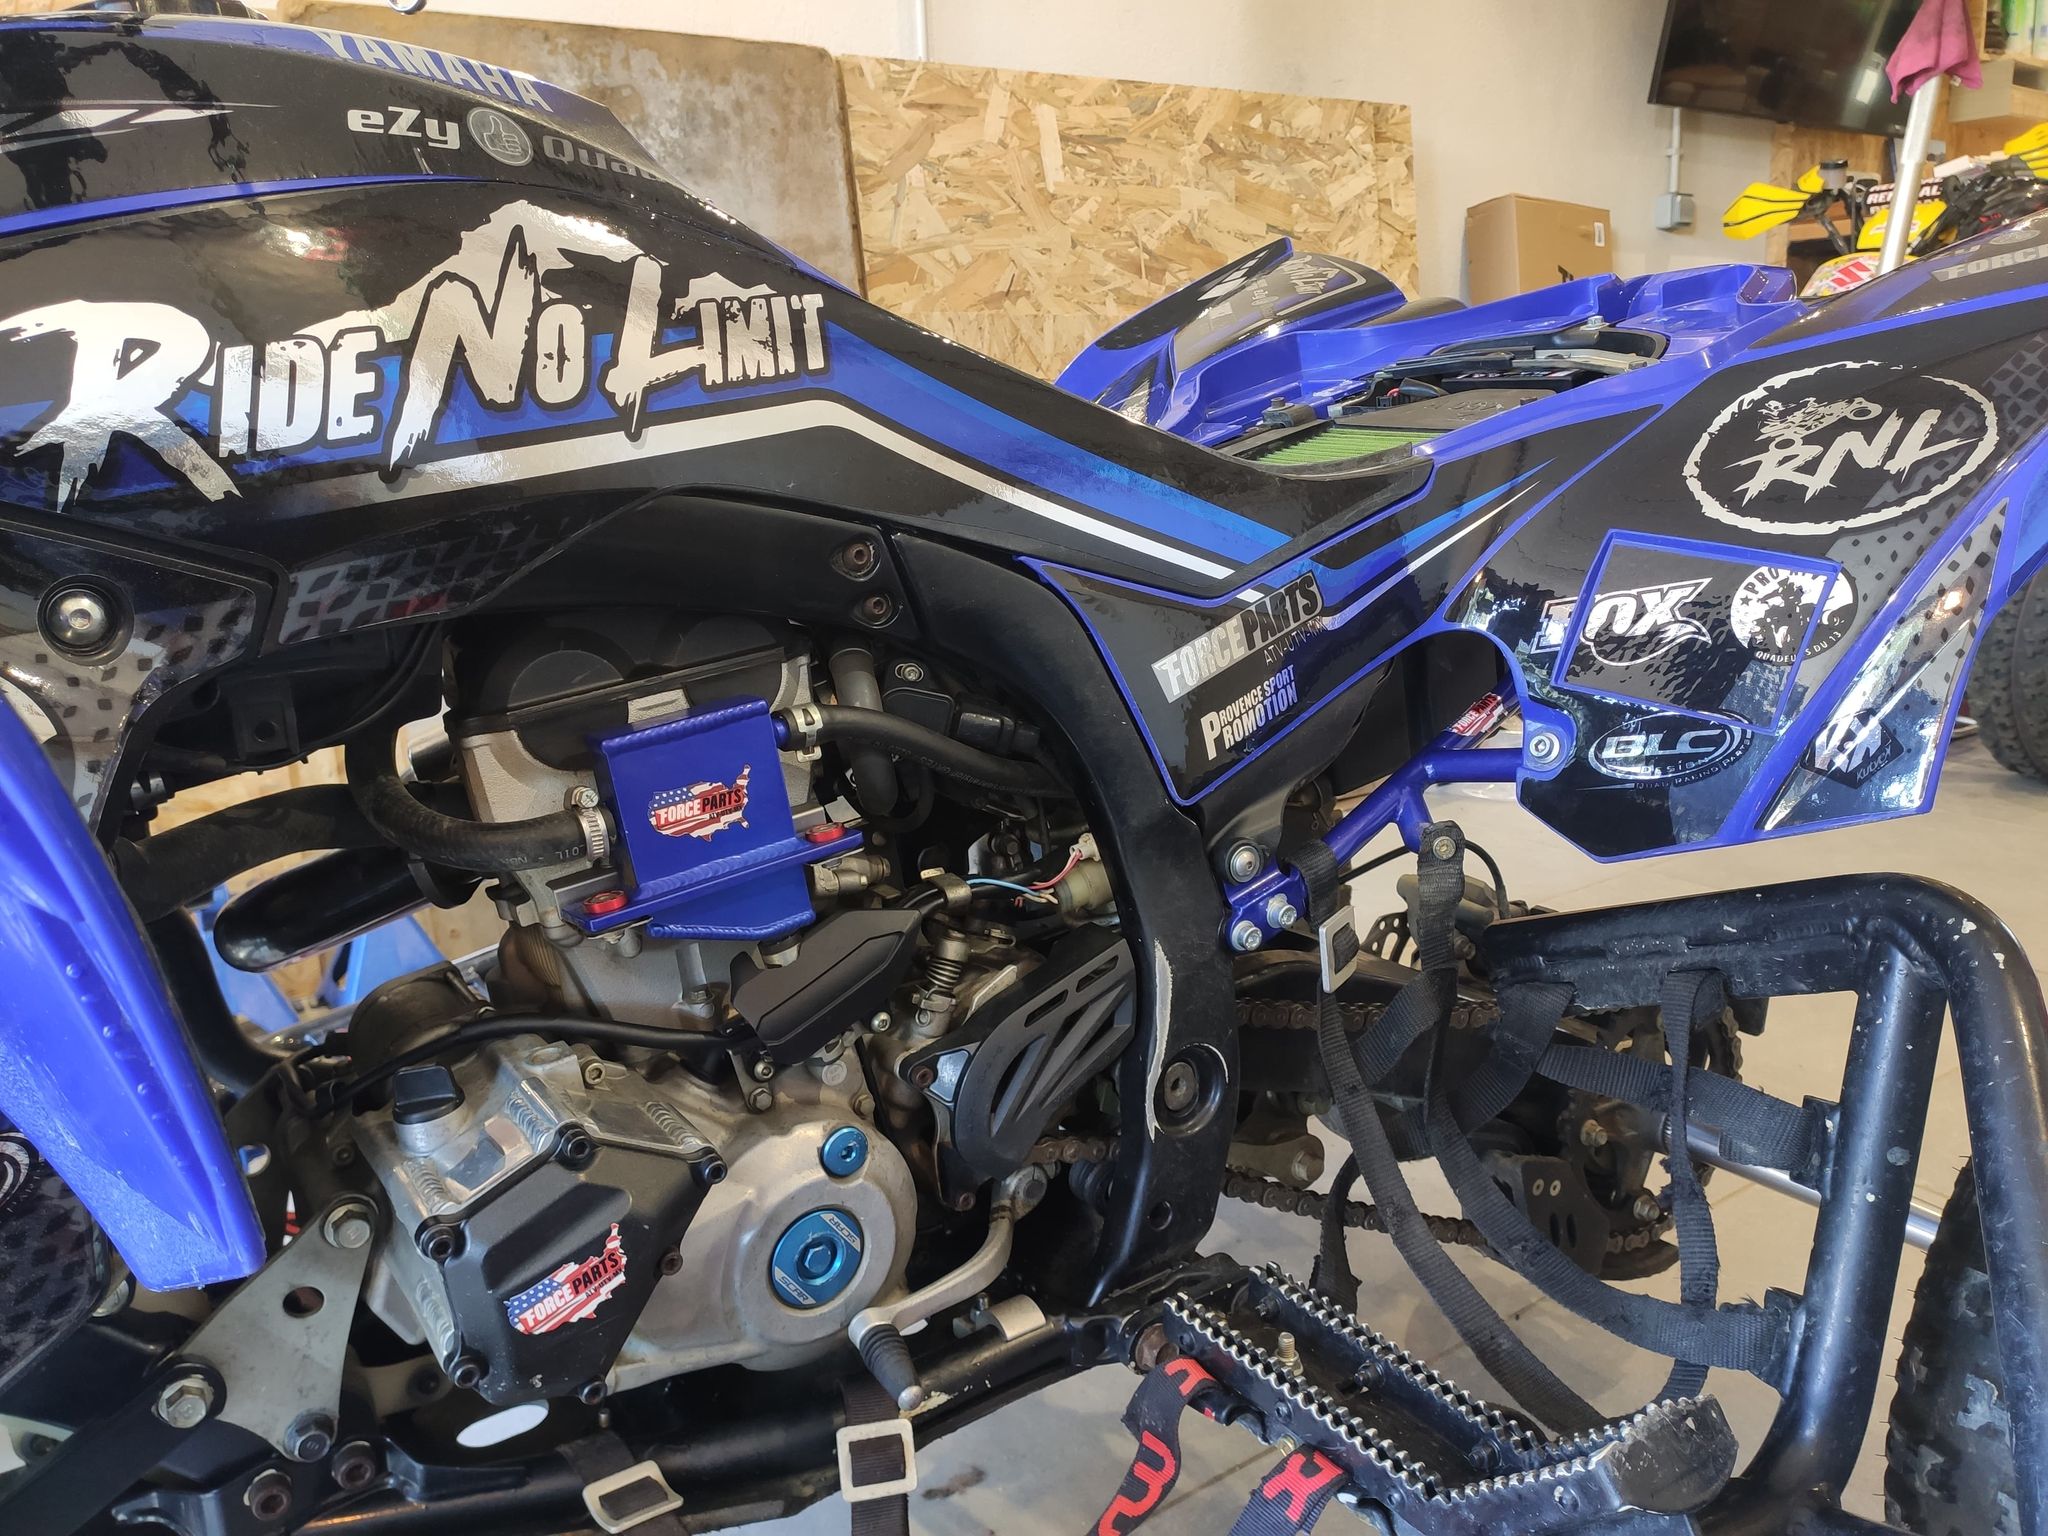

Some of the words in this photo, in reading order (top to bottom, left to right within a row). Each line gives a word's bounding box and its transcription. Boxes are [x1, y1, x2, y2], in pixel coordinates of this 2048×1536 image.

[312, 29, 553, 112] YAMAHA
[347, 105, 461, 150] eZy
[0, 299, 379, 513] RIDE
[603, 254, 825, 433] LIMIT
[1722, 407, 1983, 508] RNL
[1755, 645, 1812, 663] QUADEUS
[1263, 664, 1295, 696] SPORT
[1601, 729, 1724, 759] BLC
[828, 1216, 858, 1244] SCAR
[779, 1275, 809, 1302] SCAR
